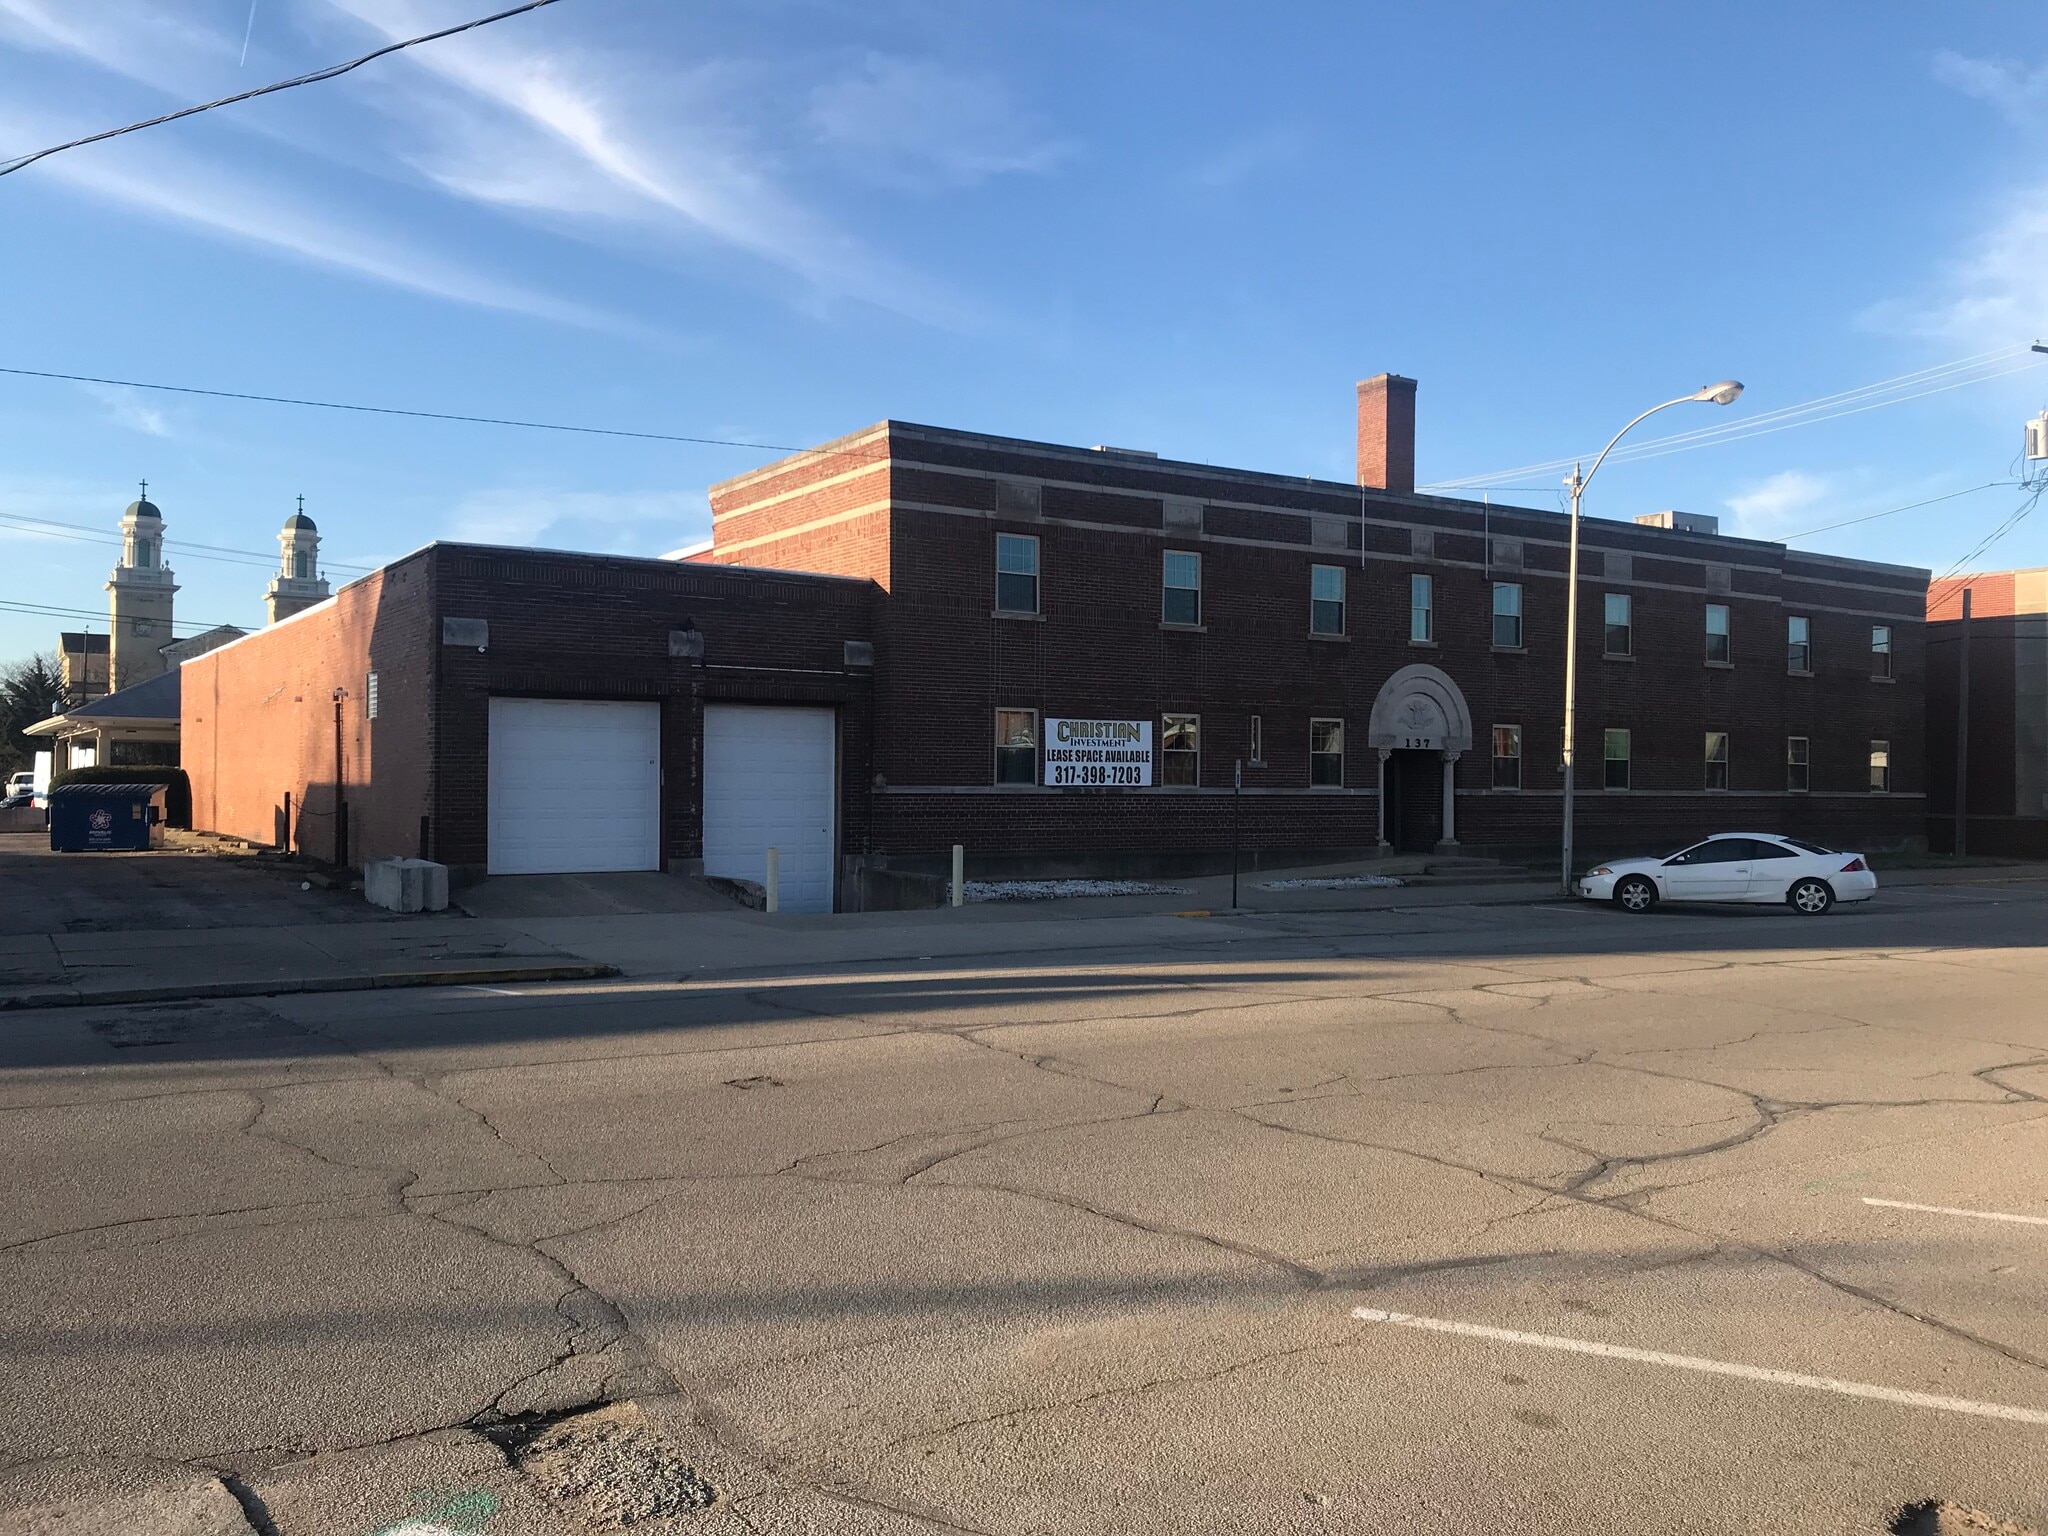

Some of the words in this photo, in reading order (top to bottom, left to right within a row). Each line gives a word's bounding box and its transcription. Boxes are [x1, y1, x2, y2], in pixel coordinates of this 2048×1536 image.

[1057, 721, 1141, 742] CHRISTIAN
[1070, 738, 1126, 747] INVESTMENT
[1405, 738, 1430, 748] 137
[1047, 749, 1073, 762] LEASE
[1075, 749, 1103, 762] SPACE
[1105, 750, 1150, 763] AVAILABLE
[1055, 766, 1141, 784] 317-398-7203
